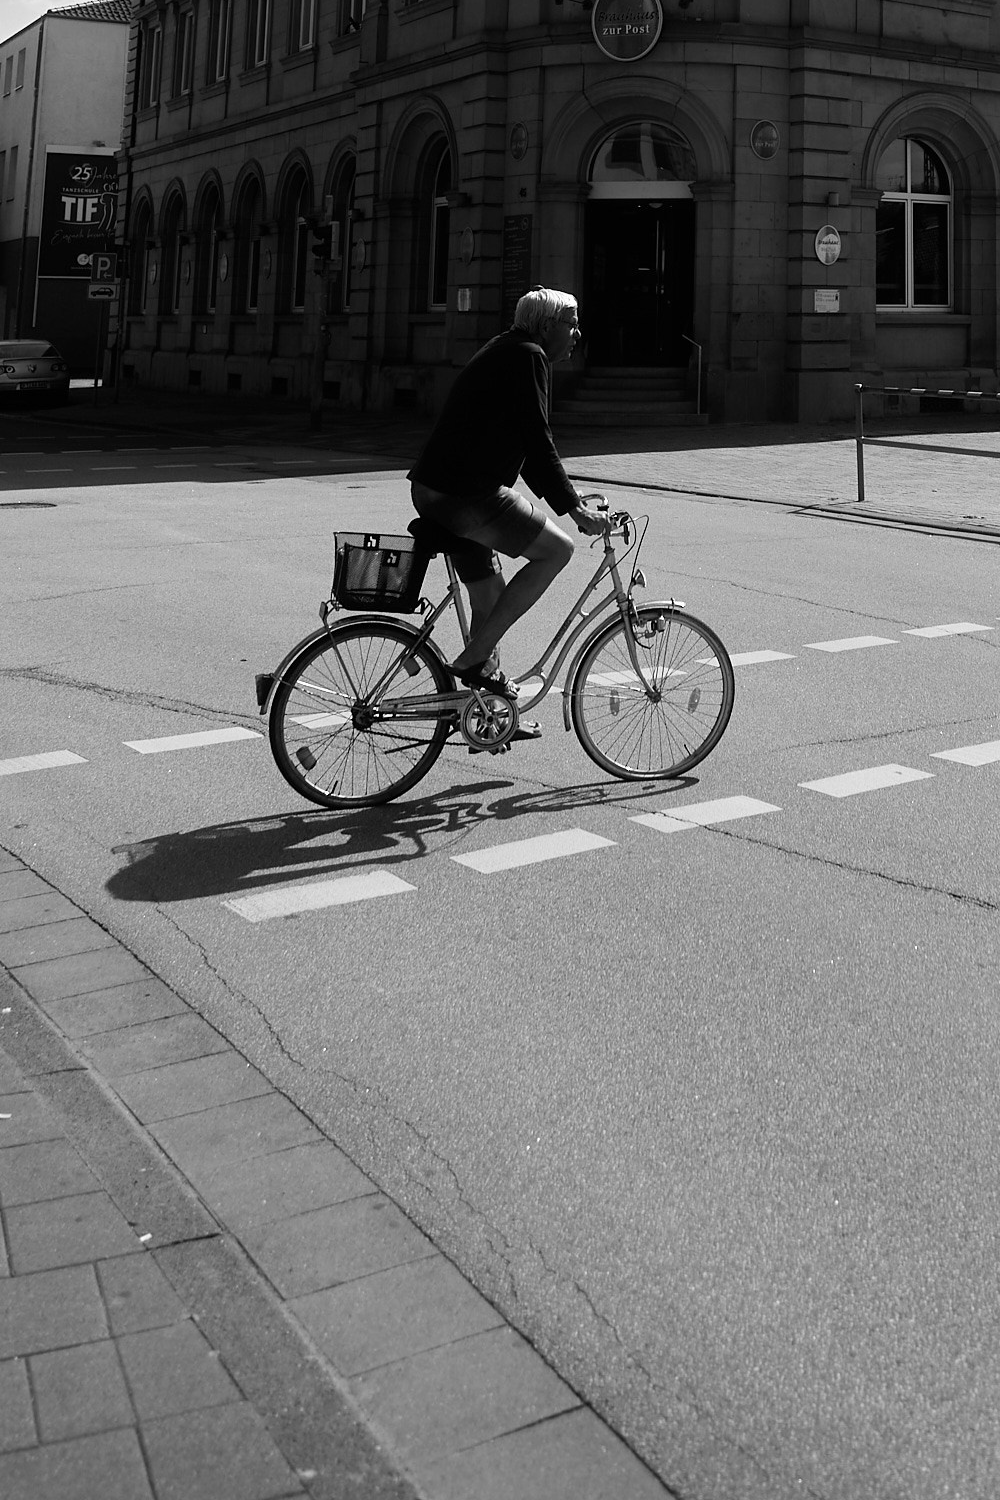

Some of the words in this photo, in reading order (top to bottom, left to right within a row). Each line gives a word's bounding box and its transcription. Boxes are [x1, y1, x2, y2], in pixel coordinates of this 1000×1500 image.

[602, 27, 622, 36] zur
[625, 24, 650, 35] Post
[71, 166, 92, 181] 25
[97, 257, 111, 280] P
